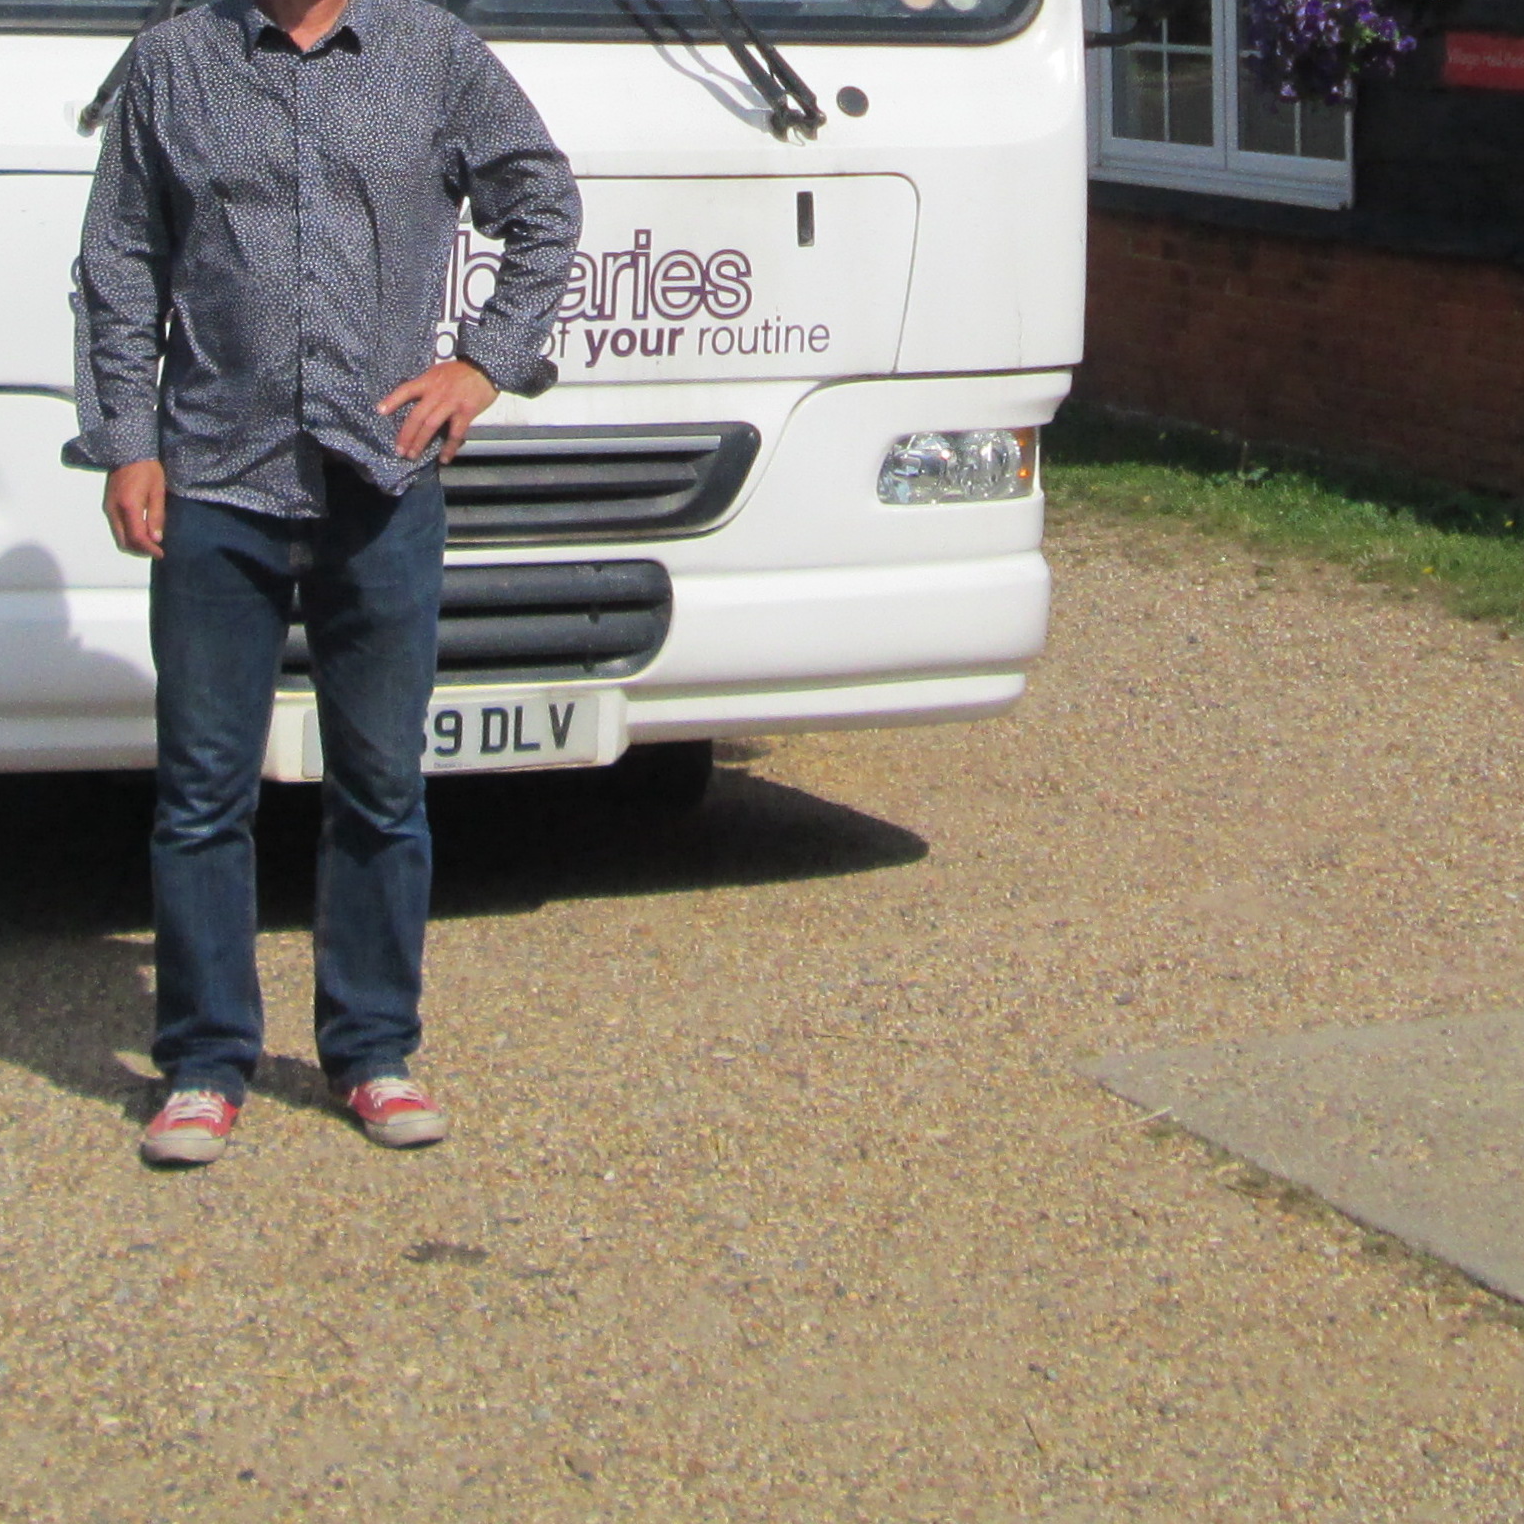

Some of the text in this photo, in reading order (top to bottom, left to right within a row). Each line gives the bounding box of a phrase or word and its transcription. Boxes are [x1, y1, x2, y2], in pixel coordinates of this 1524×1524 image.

[440, 229, 753, 320] baries
[584, 325, 684, 368] your
[698, 316, 831, 356] routine
[479, 702, 575, 755] DLV
